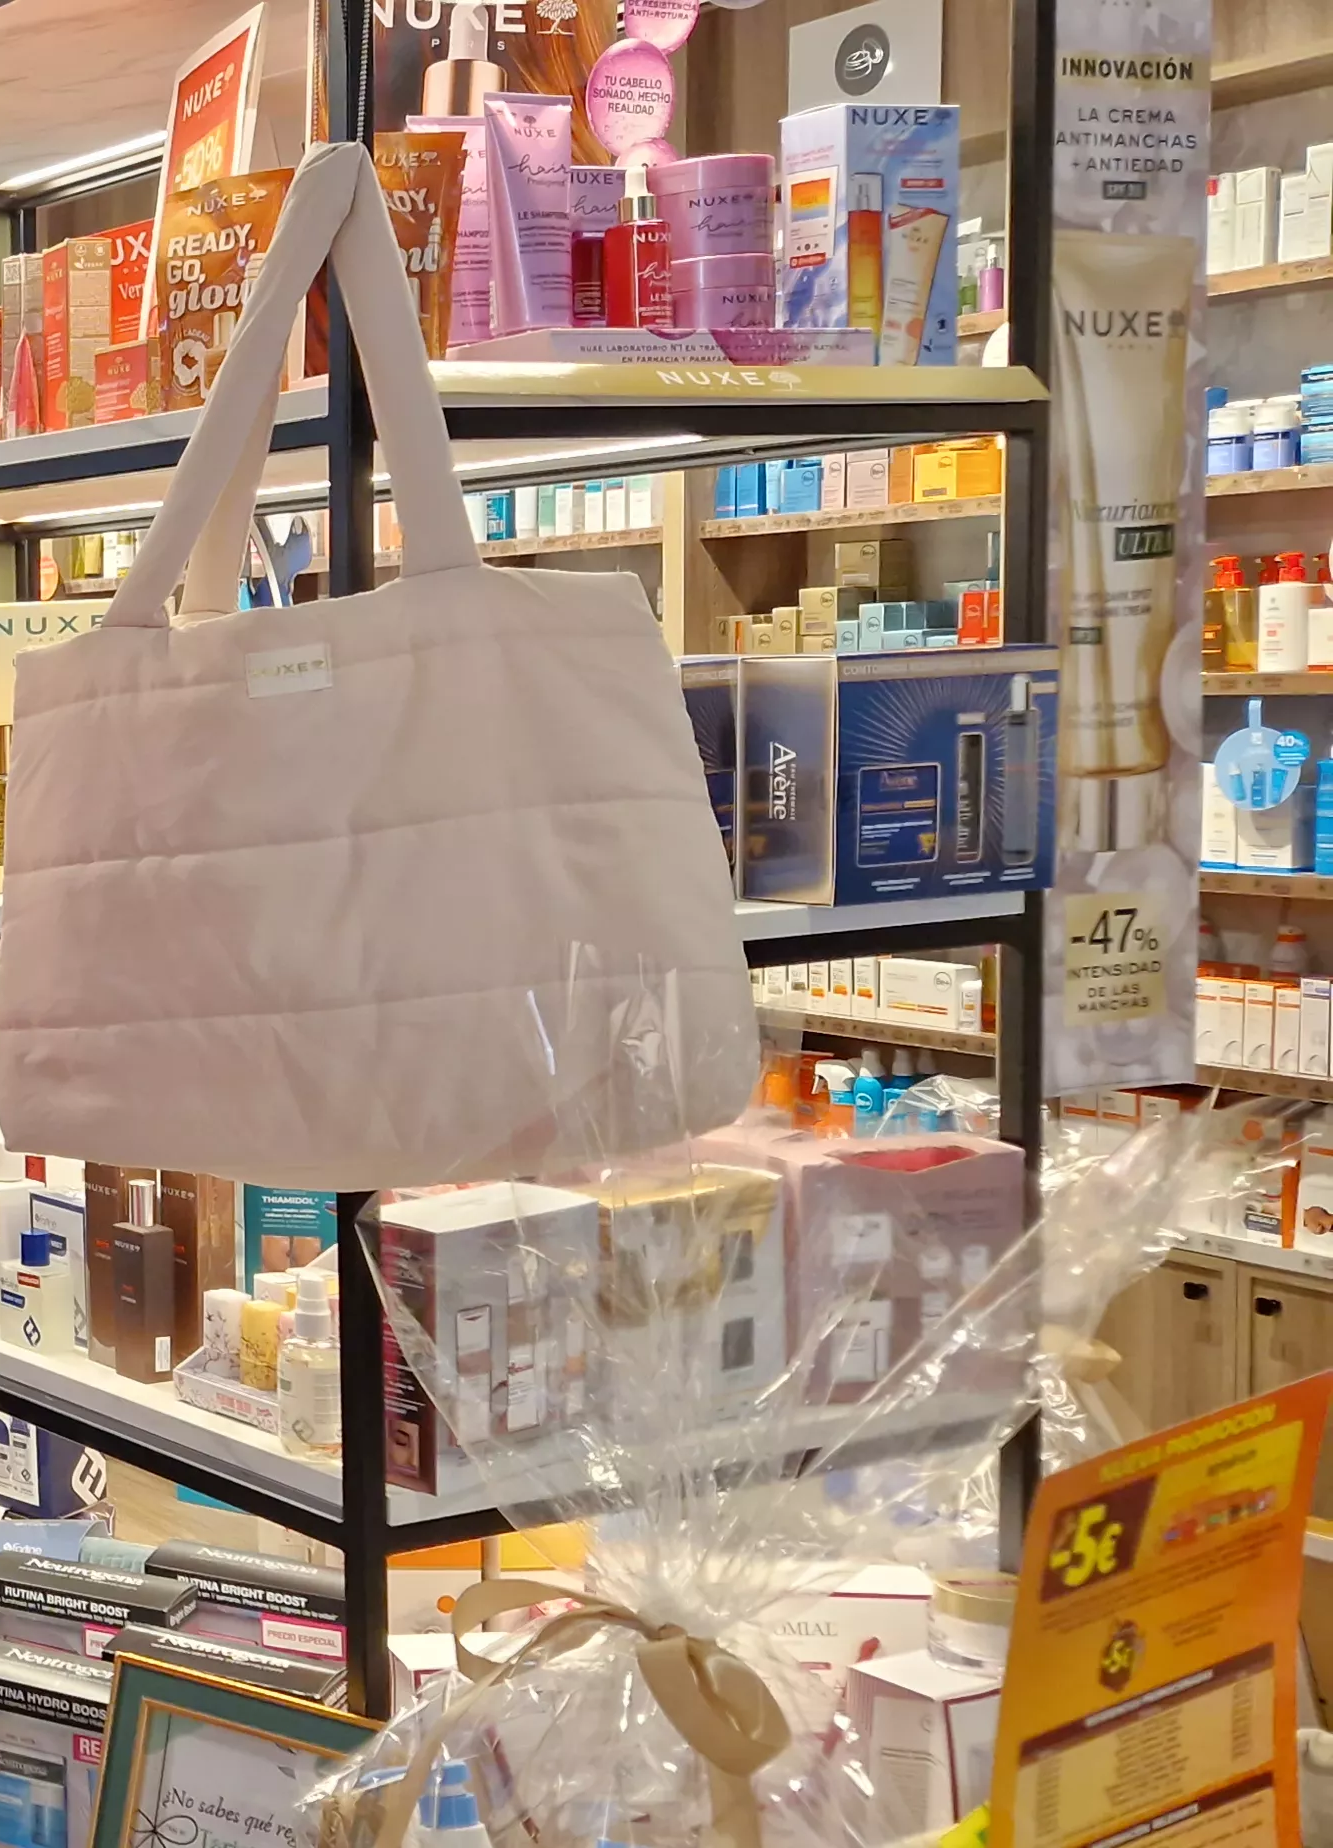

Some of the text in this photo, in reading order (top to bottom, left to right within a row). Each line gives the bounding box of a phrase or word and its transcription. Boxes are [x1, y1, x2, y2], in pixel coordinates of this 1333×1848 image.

[629, 9, 690, 20] ANTI-ROTURA
[1062, 57, 1194, 80] INNOVACIÓN
[604, 76, 662, 89] TU CABELLO
[183, 69, 225, 121] NUXE
[593, 87, 671, 104] SOÑADO, HECHO
[608, 102, 655, 115] REALIDAD
[852, 109, 930, 126] NUXE
[1078, 108, 1176, 124] LA CREMA
[514, 128, 557, 138] NUXE
[1056, 132, 1197, 149] ANTIMANCHAS
[174, 134, 224, 189] -50%
[1086, 158, 1184, 173] ANTIEDAD
[186, 191, 247, 218] NUXE
[383, 187, 436, 213] ADY,
[167, 223, 256, 258] READY,
[633, 232, 671, 243] NUX
[167, 259, 206, 285] GO,
[1064, 310, 1165, 338] NUXE
[636, 355, 680, 363] FARMACIA
[656, 369, 766, 387] NUXE
[773, 742, 797, 820] Avène
[1070, 906, 1159, 956] -47%
[1067, 960, 1162, 979] INTENSIDAD
[1087, 984, 1140, 998] DE LAS
[1078, 997, 1150, 1013] MANCHAS
[85, 1182, 110, 1196] NUXE
[161, 1185, 188, 1199] NUXE
[114, 1239, 136, 1252] NUXE
[1049, 1504, 1123, 1587] -5€
[197, 1547, 319, 1575] Neutrogena
[25, 1557, 145, 1586] Neutrogena
[4, 1585, 131, 1619] RUTINA BRIGHT BOOST
[221, 1583, 265, 1602] BRIGHT
[266, 1592, 308, 1608] BOOST
[267, 1629, 337, 1648] PRECIO ESPECIAL
[5, 1648, 114, 1678] Neutrogen
[27, 1691, 70, 1712] HYDRO
[72, 1702, 108, 1721] BOOS
[162, 1787, 273, 1834] ¿No sabes qué
